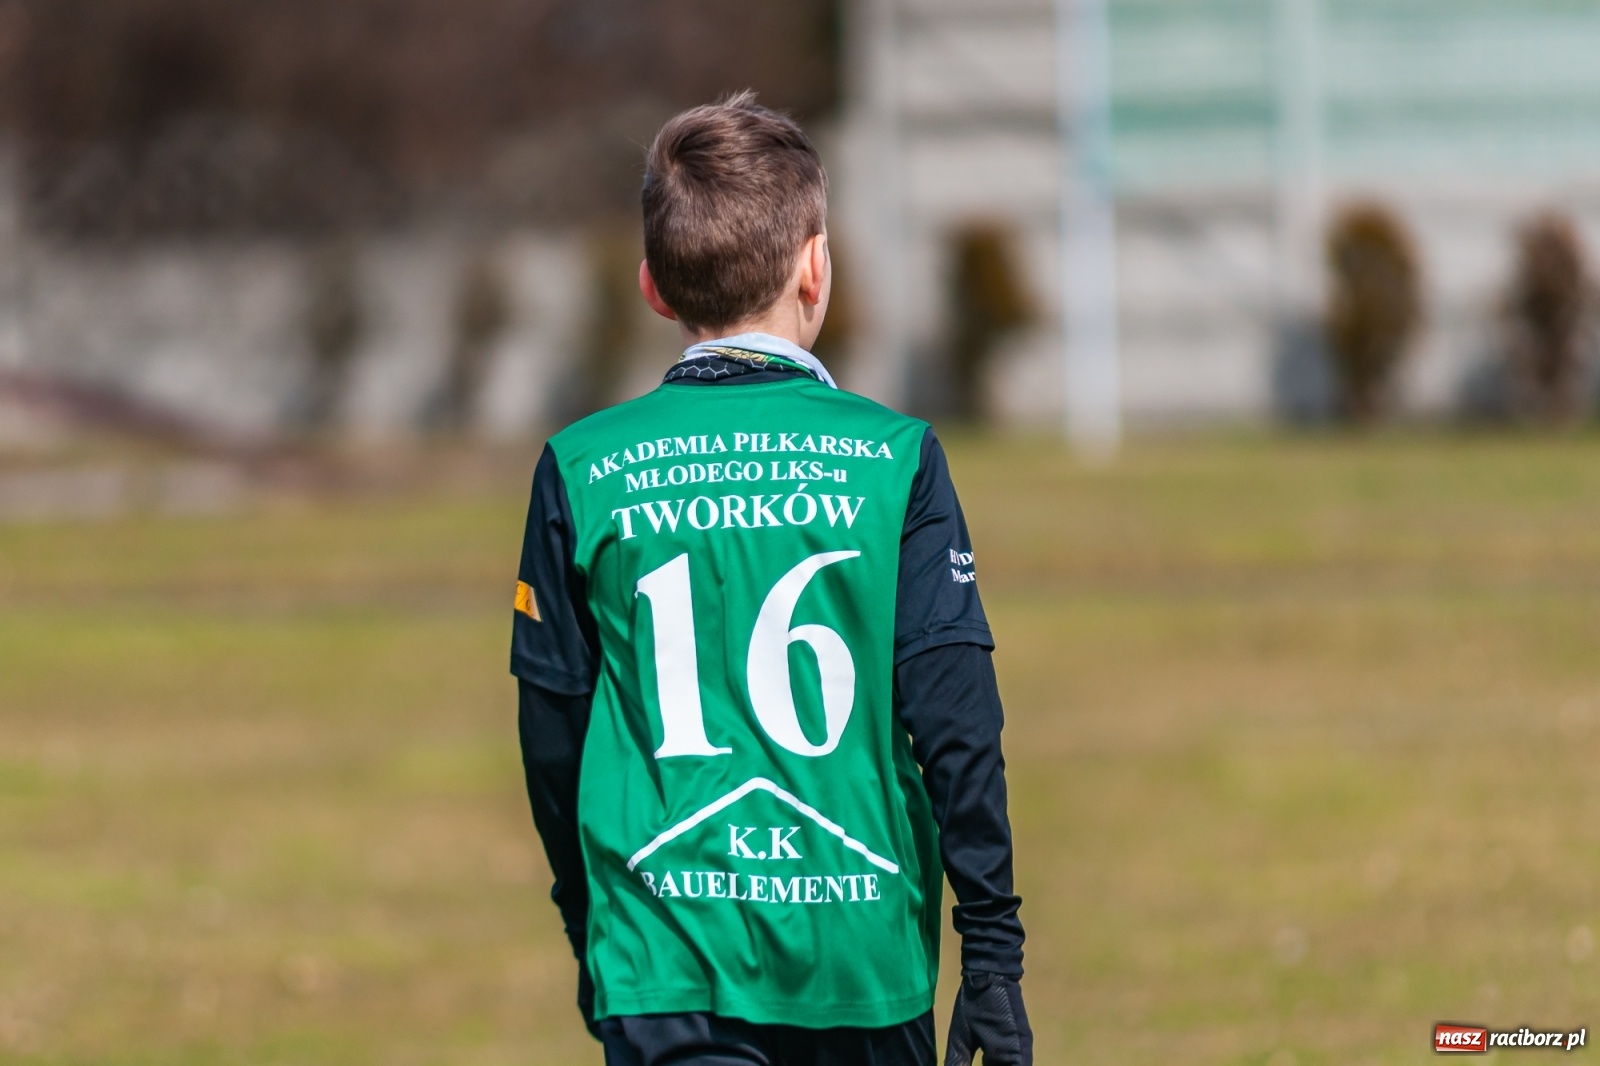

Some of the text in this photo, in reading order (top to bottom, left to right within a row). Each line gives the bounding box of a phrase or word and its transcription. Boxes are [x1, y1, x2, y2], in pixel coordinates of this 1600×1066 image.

[588, 432, 893, 484] AKADEMIA PIŁKARSKA
[625, 460, 847, 493] MŁODEGO LKS-u
[611, 483, 865, 540] TWORKÓW
[635, 550, 861, 760] 16
[728, 823, 802, 860] K.K
